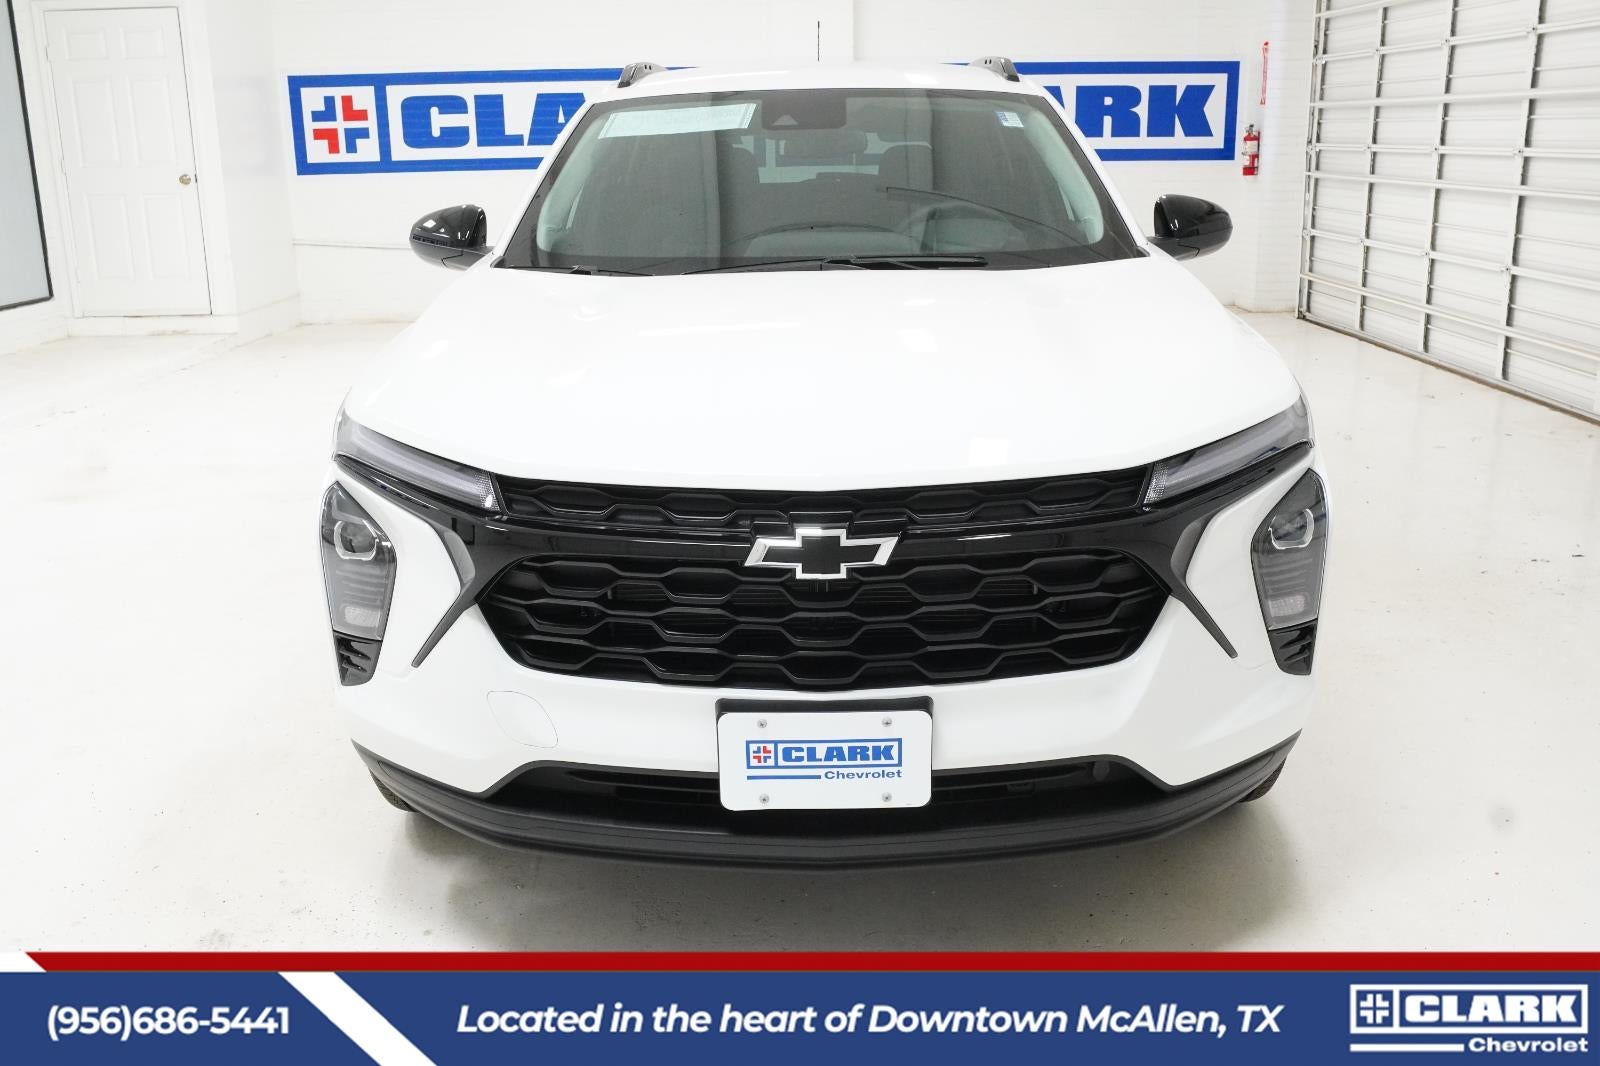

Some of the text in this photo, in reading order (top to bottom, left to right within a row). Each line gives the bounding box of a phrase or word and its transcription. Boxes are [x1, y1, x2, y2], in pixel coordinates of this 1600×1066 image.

[400, 92, 586, 149] CLA
[1043, 84, 1216, 138] RK
[781, 744, 895, 763] CLARK
[824, 769, 903, 780] Chevrolet
